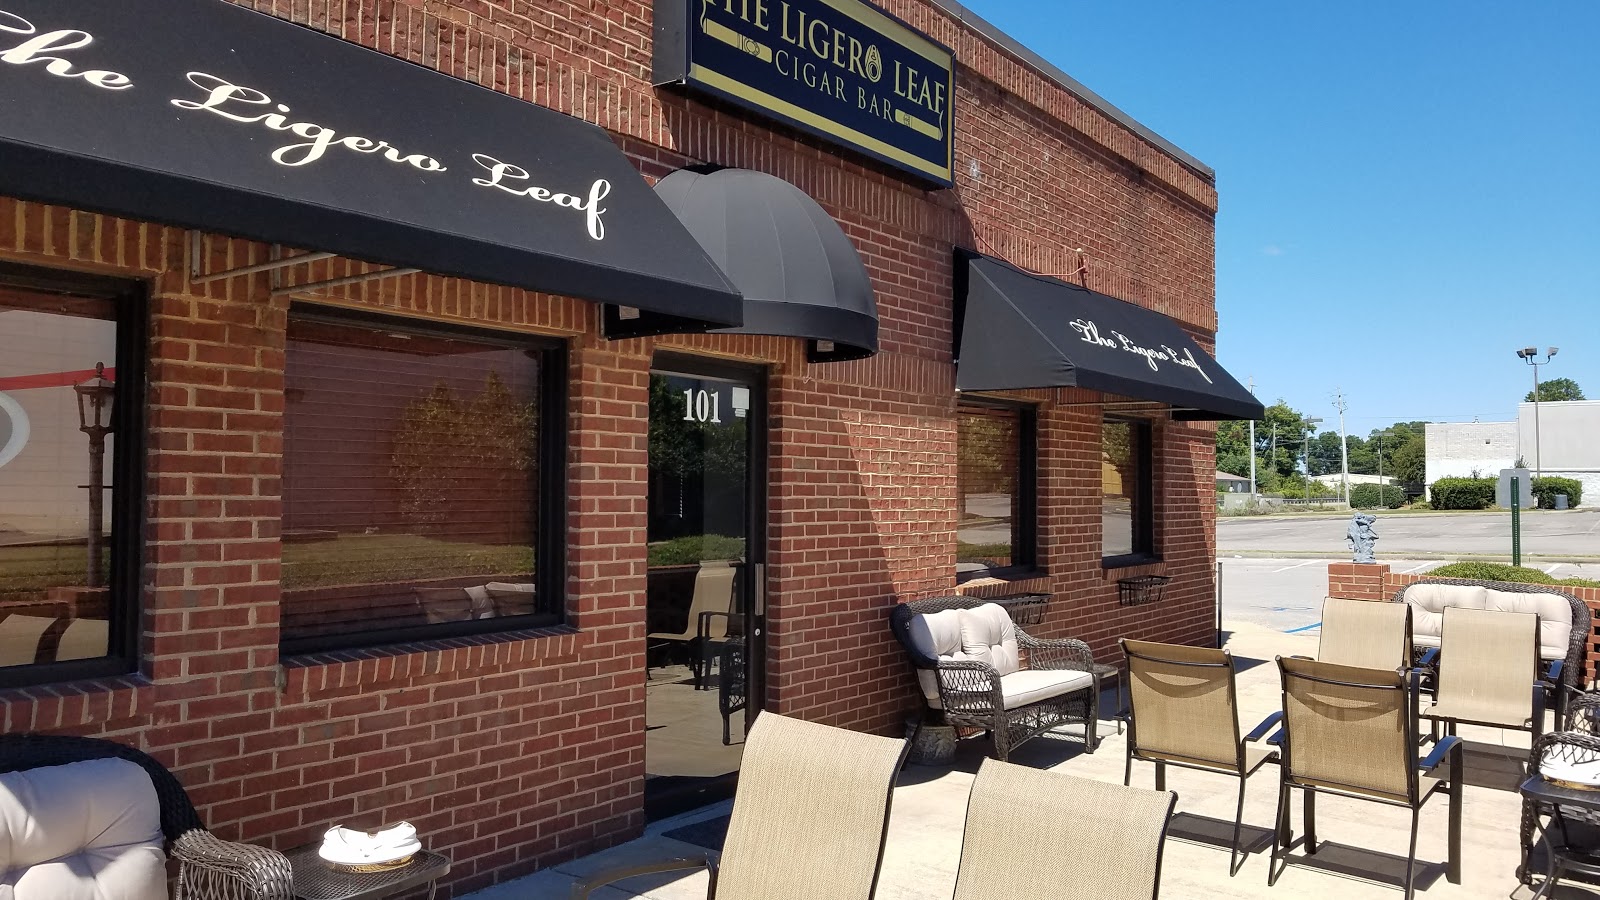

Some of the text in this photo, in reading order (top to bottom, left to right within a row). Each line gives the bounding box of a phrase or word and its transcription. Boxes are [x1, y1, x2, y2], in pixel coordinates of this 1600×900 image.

[775, 49, 894, 123] CIGAR BAR
[893, 60, 945, 114] LEAF
[170, 71, 448, 172] Ligero
[471, 153, 612, 241] Leaf
[1069, 318, 1213, 385] The Ligero Leaf
[683, 388, 722, 423] 101
